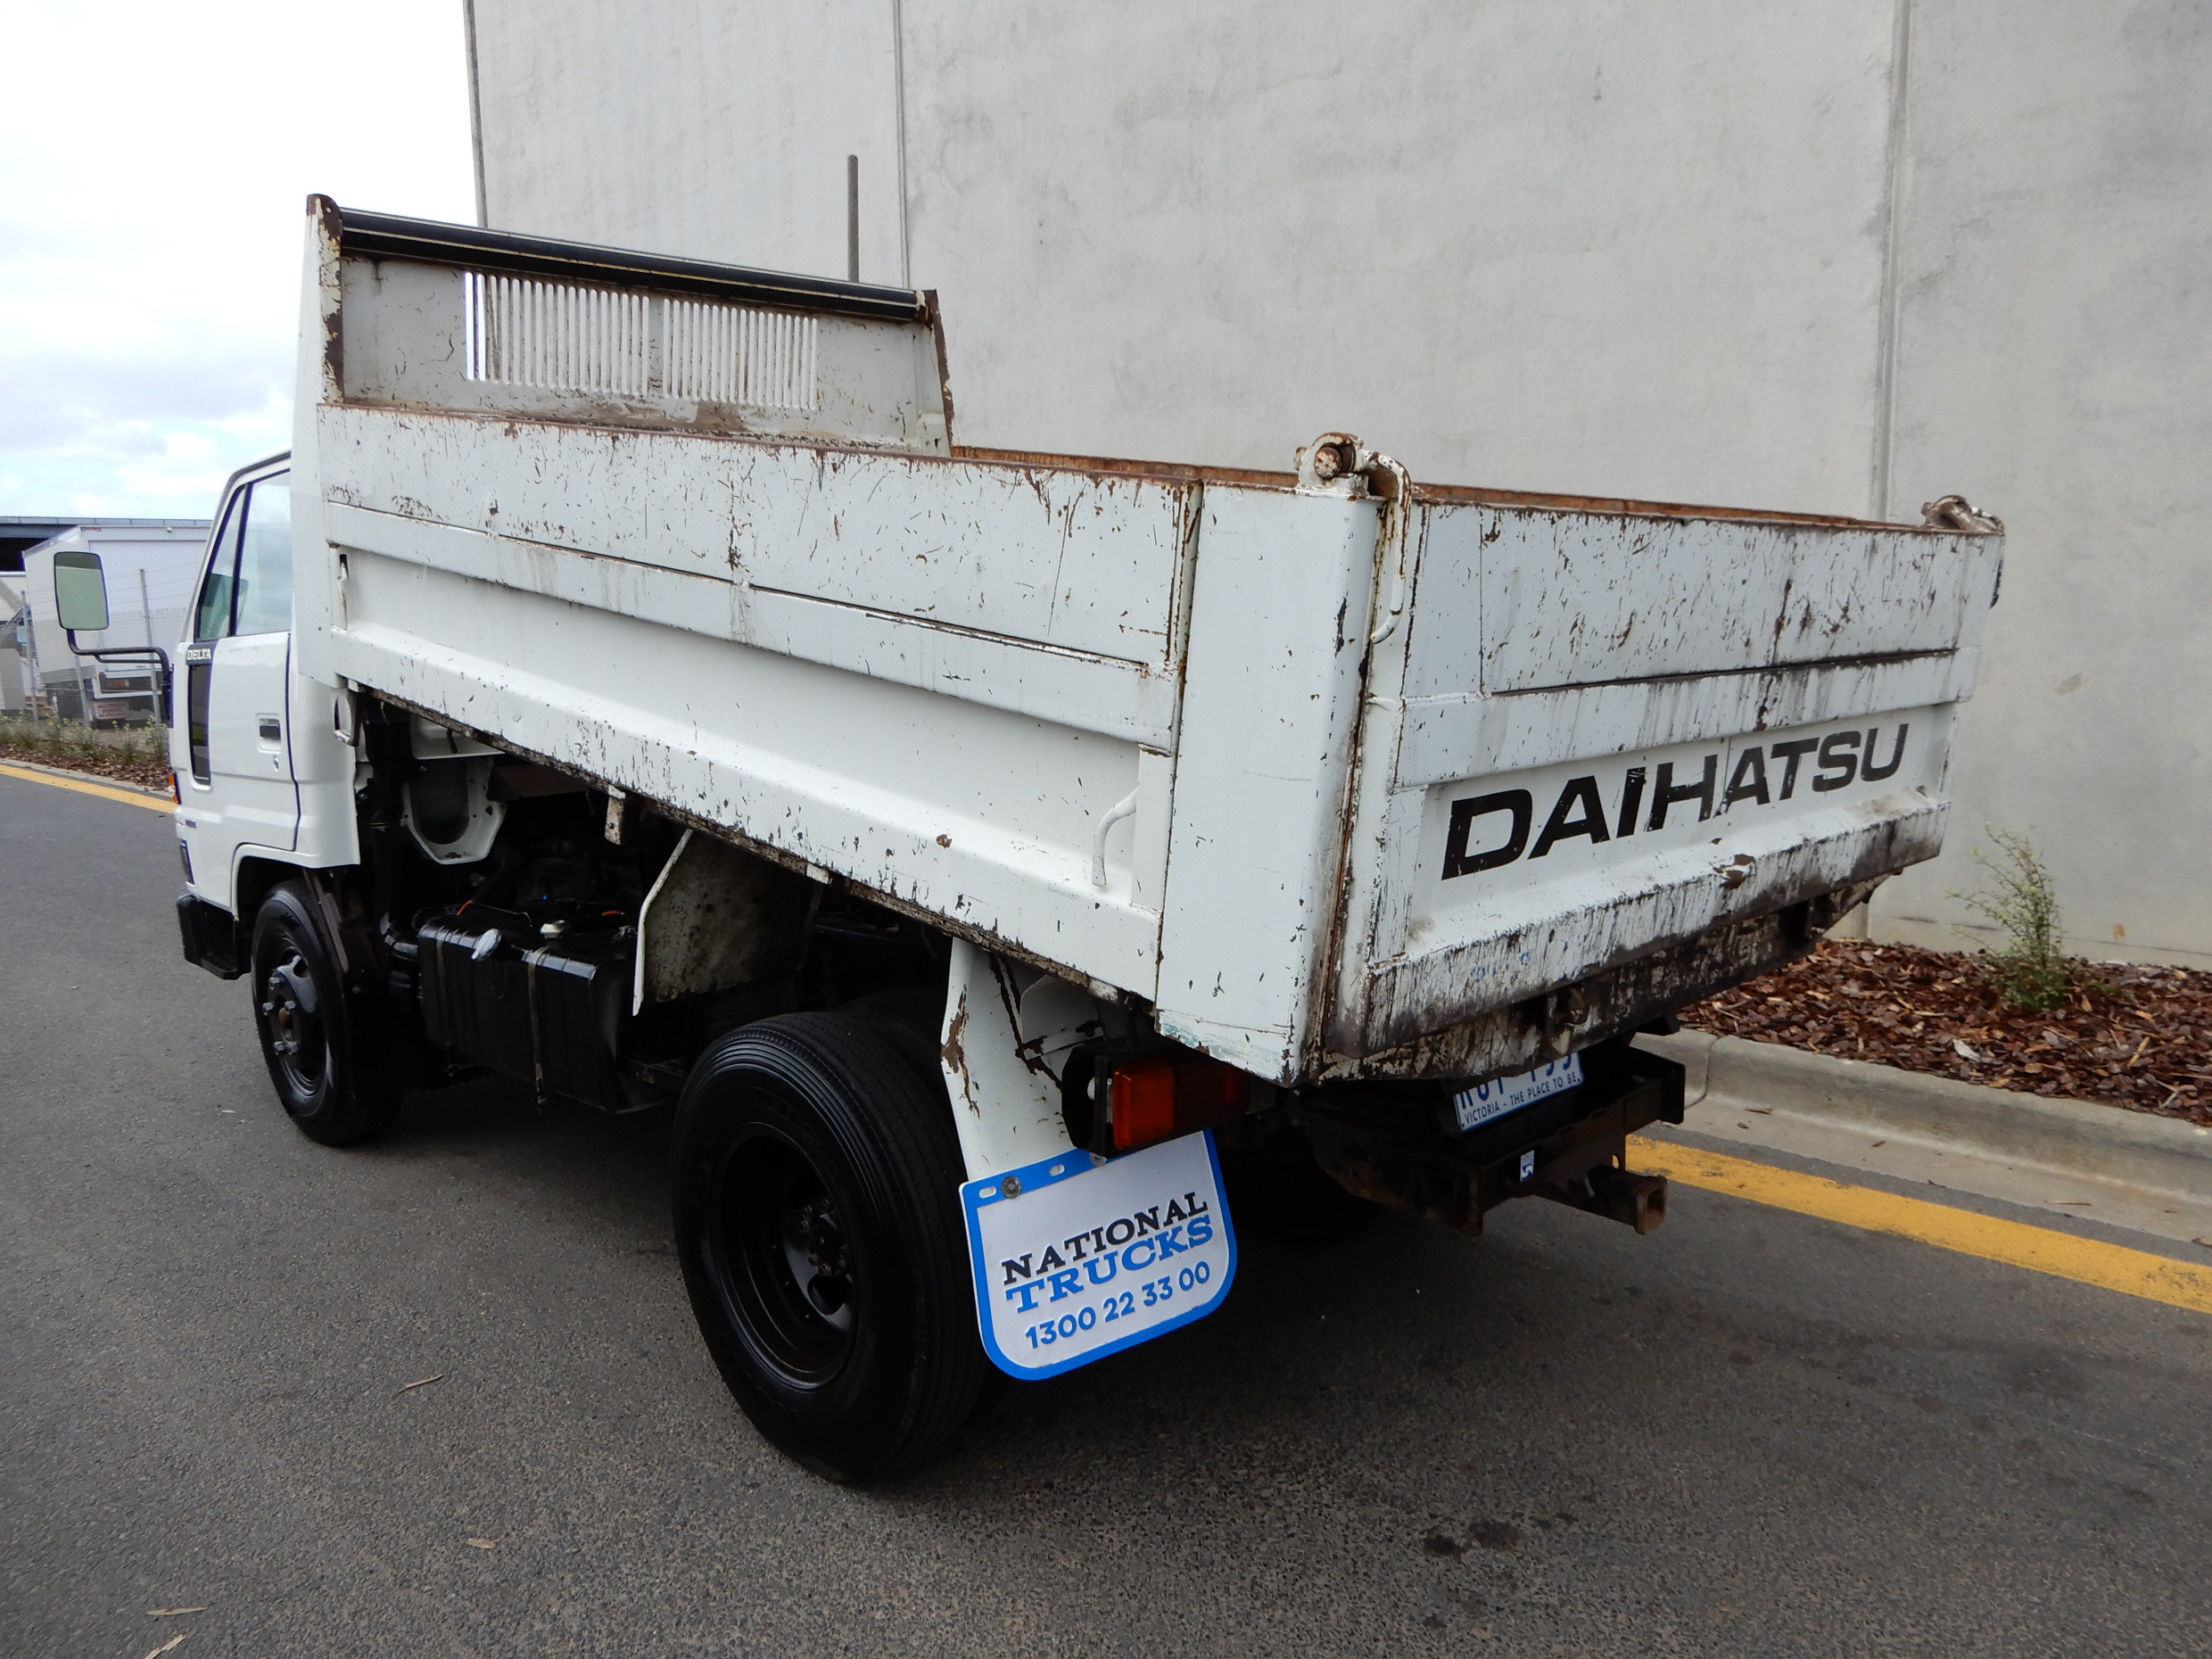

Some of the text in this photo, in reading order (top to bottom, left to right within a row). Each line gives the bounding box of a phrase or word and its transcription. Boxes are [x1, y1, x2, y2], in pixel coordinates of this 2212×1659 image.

[186, 648, 211, 660] DELTA
[1441, 723, 1909, 880] DAIHATSU
[1464, 1101, 1500, 1125] VICTORIA
[1509, 1091, 1524, 1106] THE
[1527, 1081, 1551, 1099] PLACE
[1552, 1076, 1564, 1089] TO
[1001, 1192, 1209, 1285] NATIONAL
[1005, 1215, 1213, 1313] TRUCKS
[1026, 1261, 1210, 1349] 1300 22 33 00
